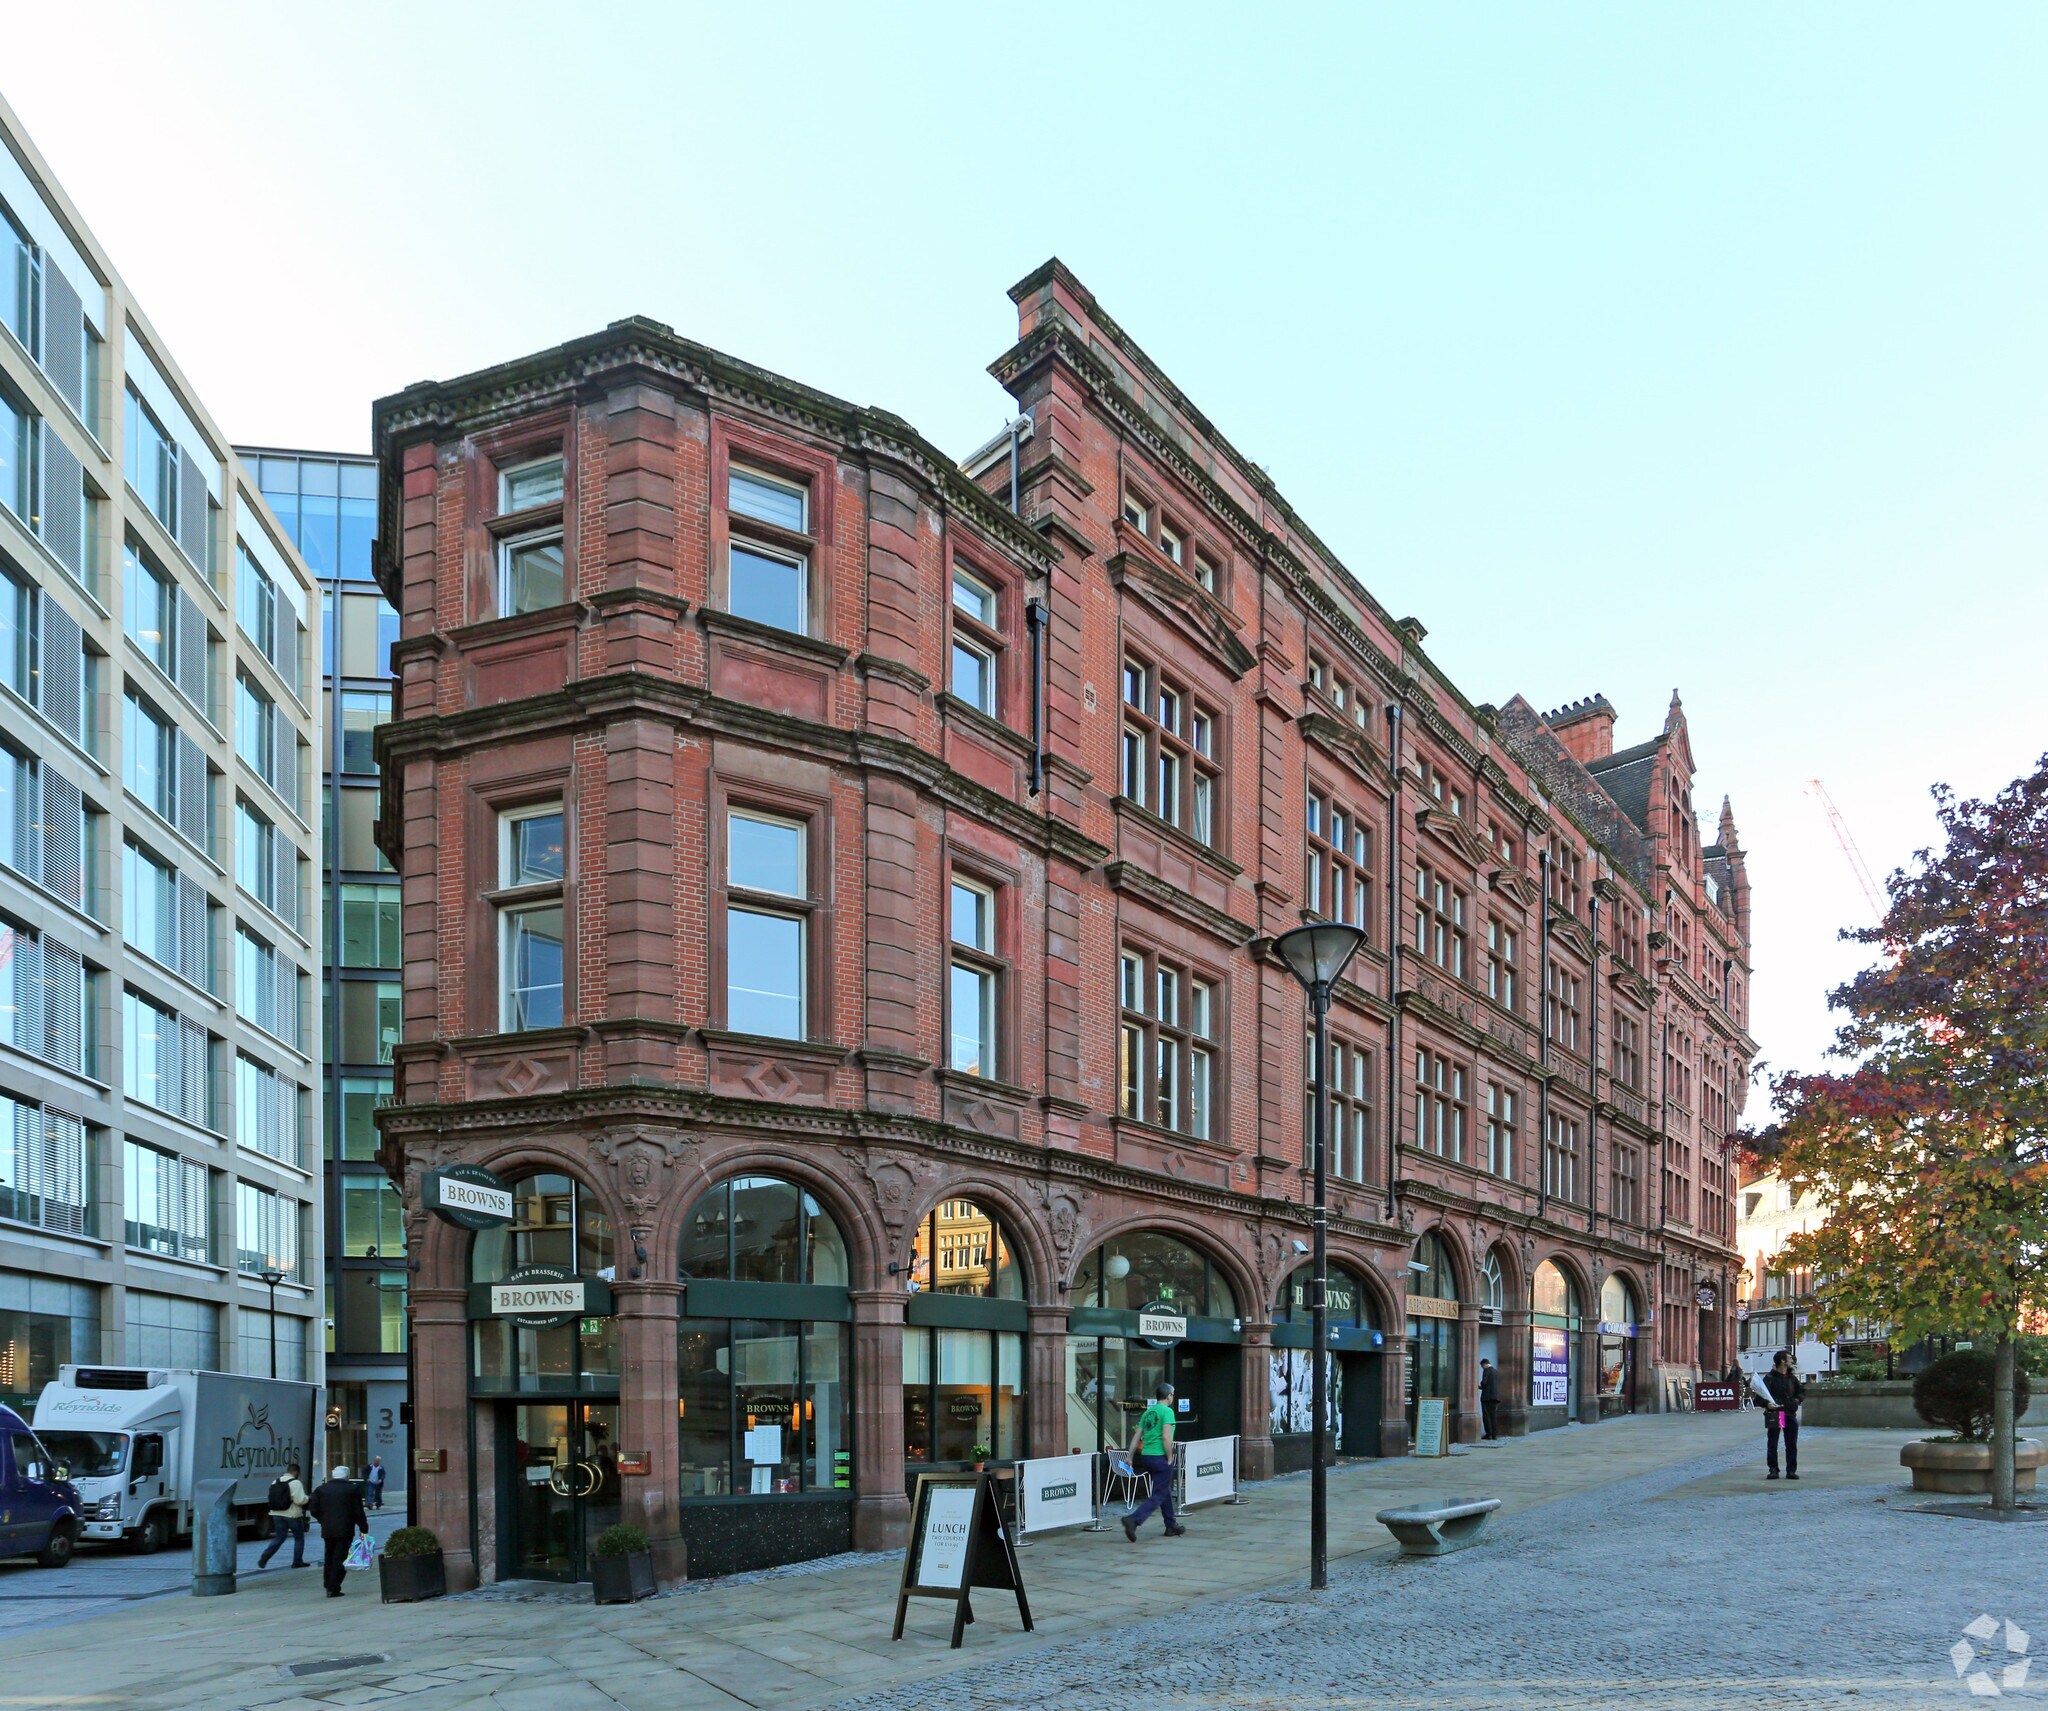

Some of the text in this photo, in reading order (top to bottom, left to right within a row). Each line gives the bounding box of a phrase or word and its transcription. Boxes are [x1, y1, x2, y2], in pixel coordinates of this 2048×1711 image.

[447, 1184, 505, 1211] BROWNS
[511, 1271, 523, 1281] BAR
[531, 1269, 564, 1279] BRASSERIE
[500, 1289, 574, 1307] BROWNS
[1295, 1286, 1350, 1310] BWNS
[1145, 1319, 1183, 1333] BROWNS
[1534, 1381, 1541, 1400] TO
[1543, 1381, 1552, 1400] LET
[52, 1402, 122, 1414] Reynolds
[746, 1404, 790, 1413] BROWNS
[951, 1404, 979, 1413] BROWNS
[380, 1408, 393, 1430] 3
[220, 1437, 300, 1479] Reynolds
[1199, 1465, 1221, 1475] BROWNS
[1044, 1486, 1074, 1498] BROWNS
[932, 1523, 966, 1533] LUNCH
